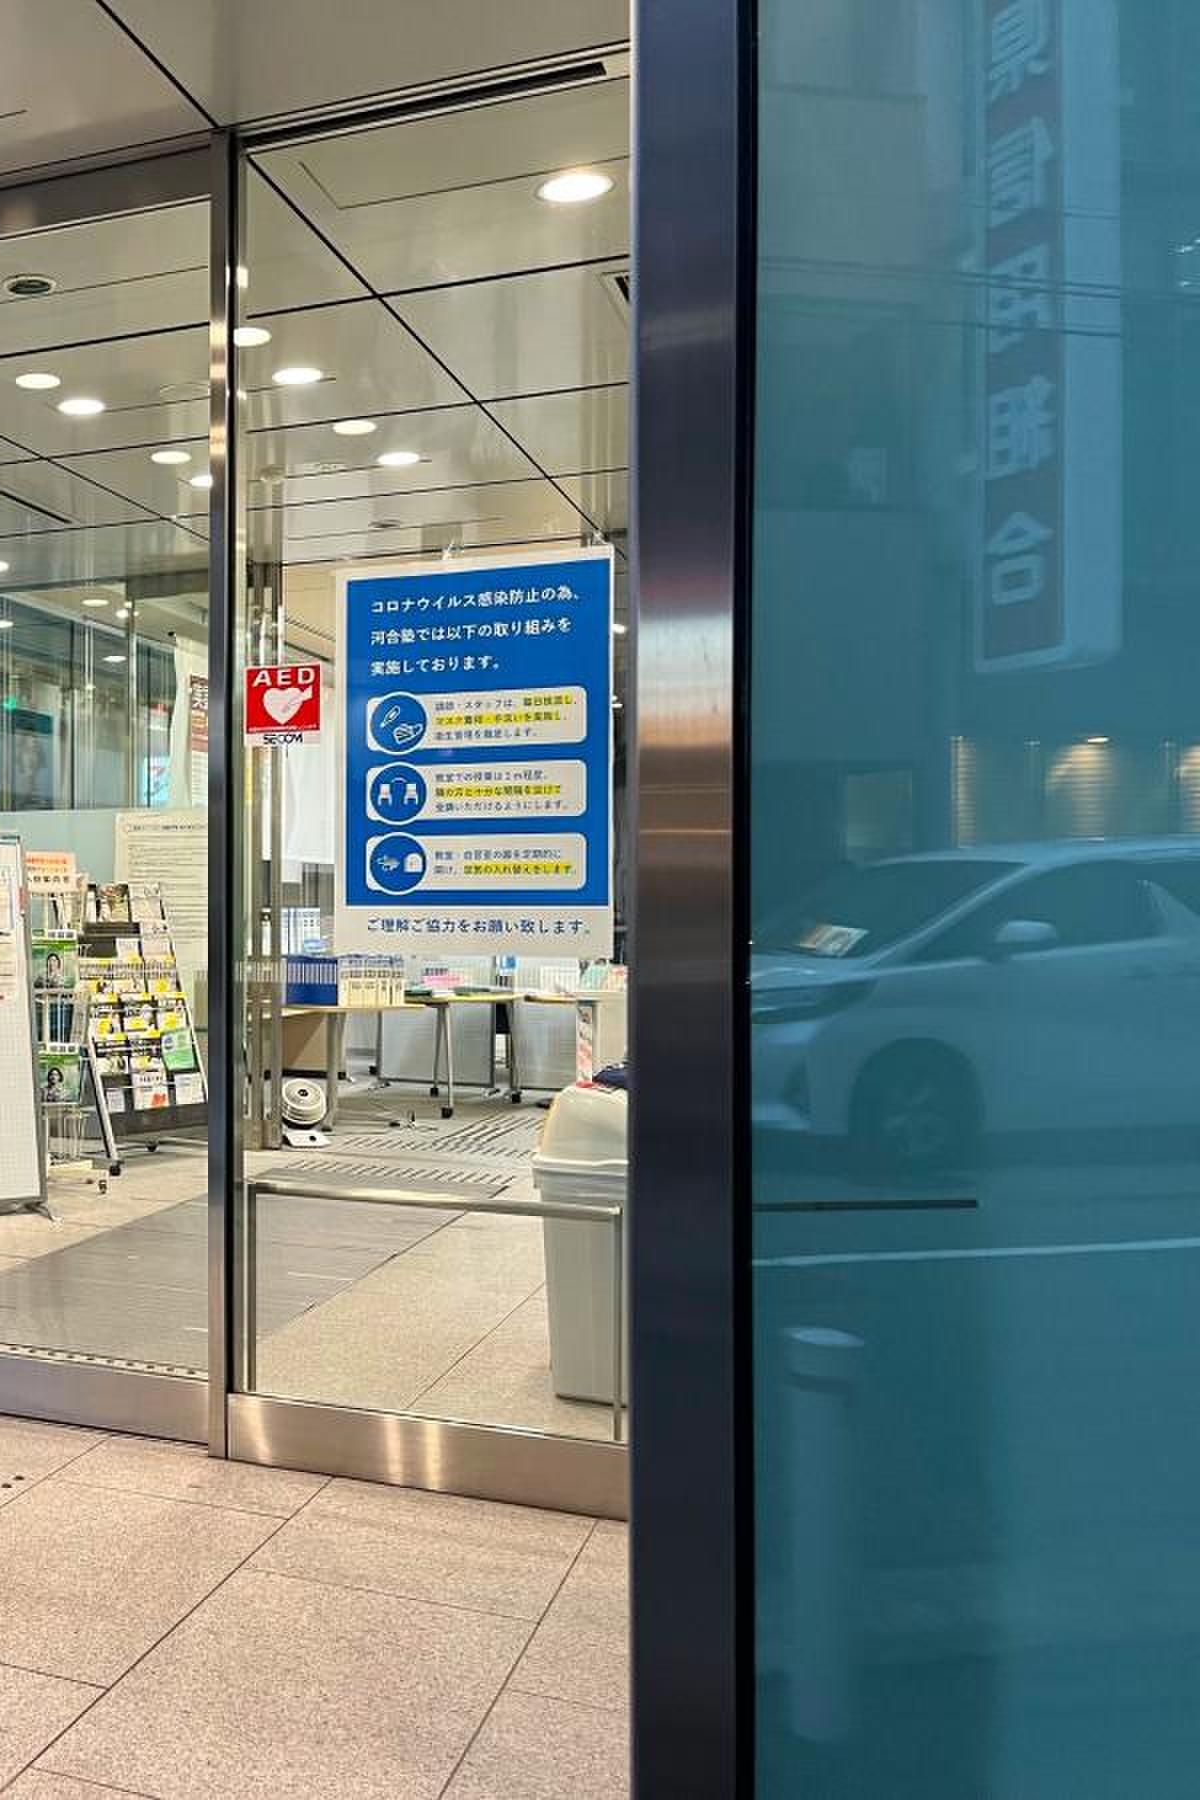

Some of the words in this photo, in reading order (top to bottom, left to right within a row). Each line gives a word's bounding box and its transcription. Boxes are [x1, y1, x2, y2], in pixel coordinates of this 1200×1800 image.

[370, 585, 579, 613] コロナウイルス感染防止の為、
[370, 618, 572, 646] 河合塾では以下の取り組みを
[370, 655, 500, 676] 実施しております。
[252, 667, 315, 687] AED
[263, 734, 304, 745] SECOM
[368, 918, 592, 935] ご理解ご協力をお願い致します。
